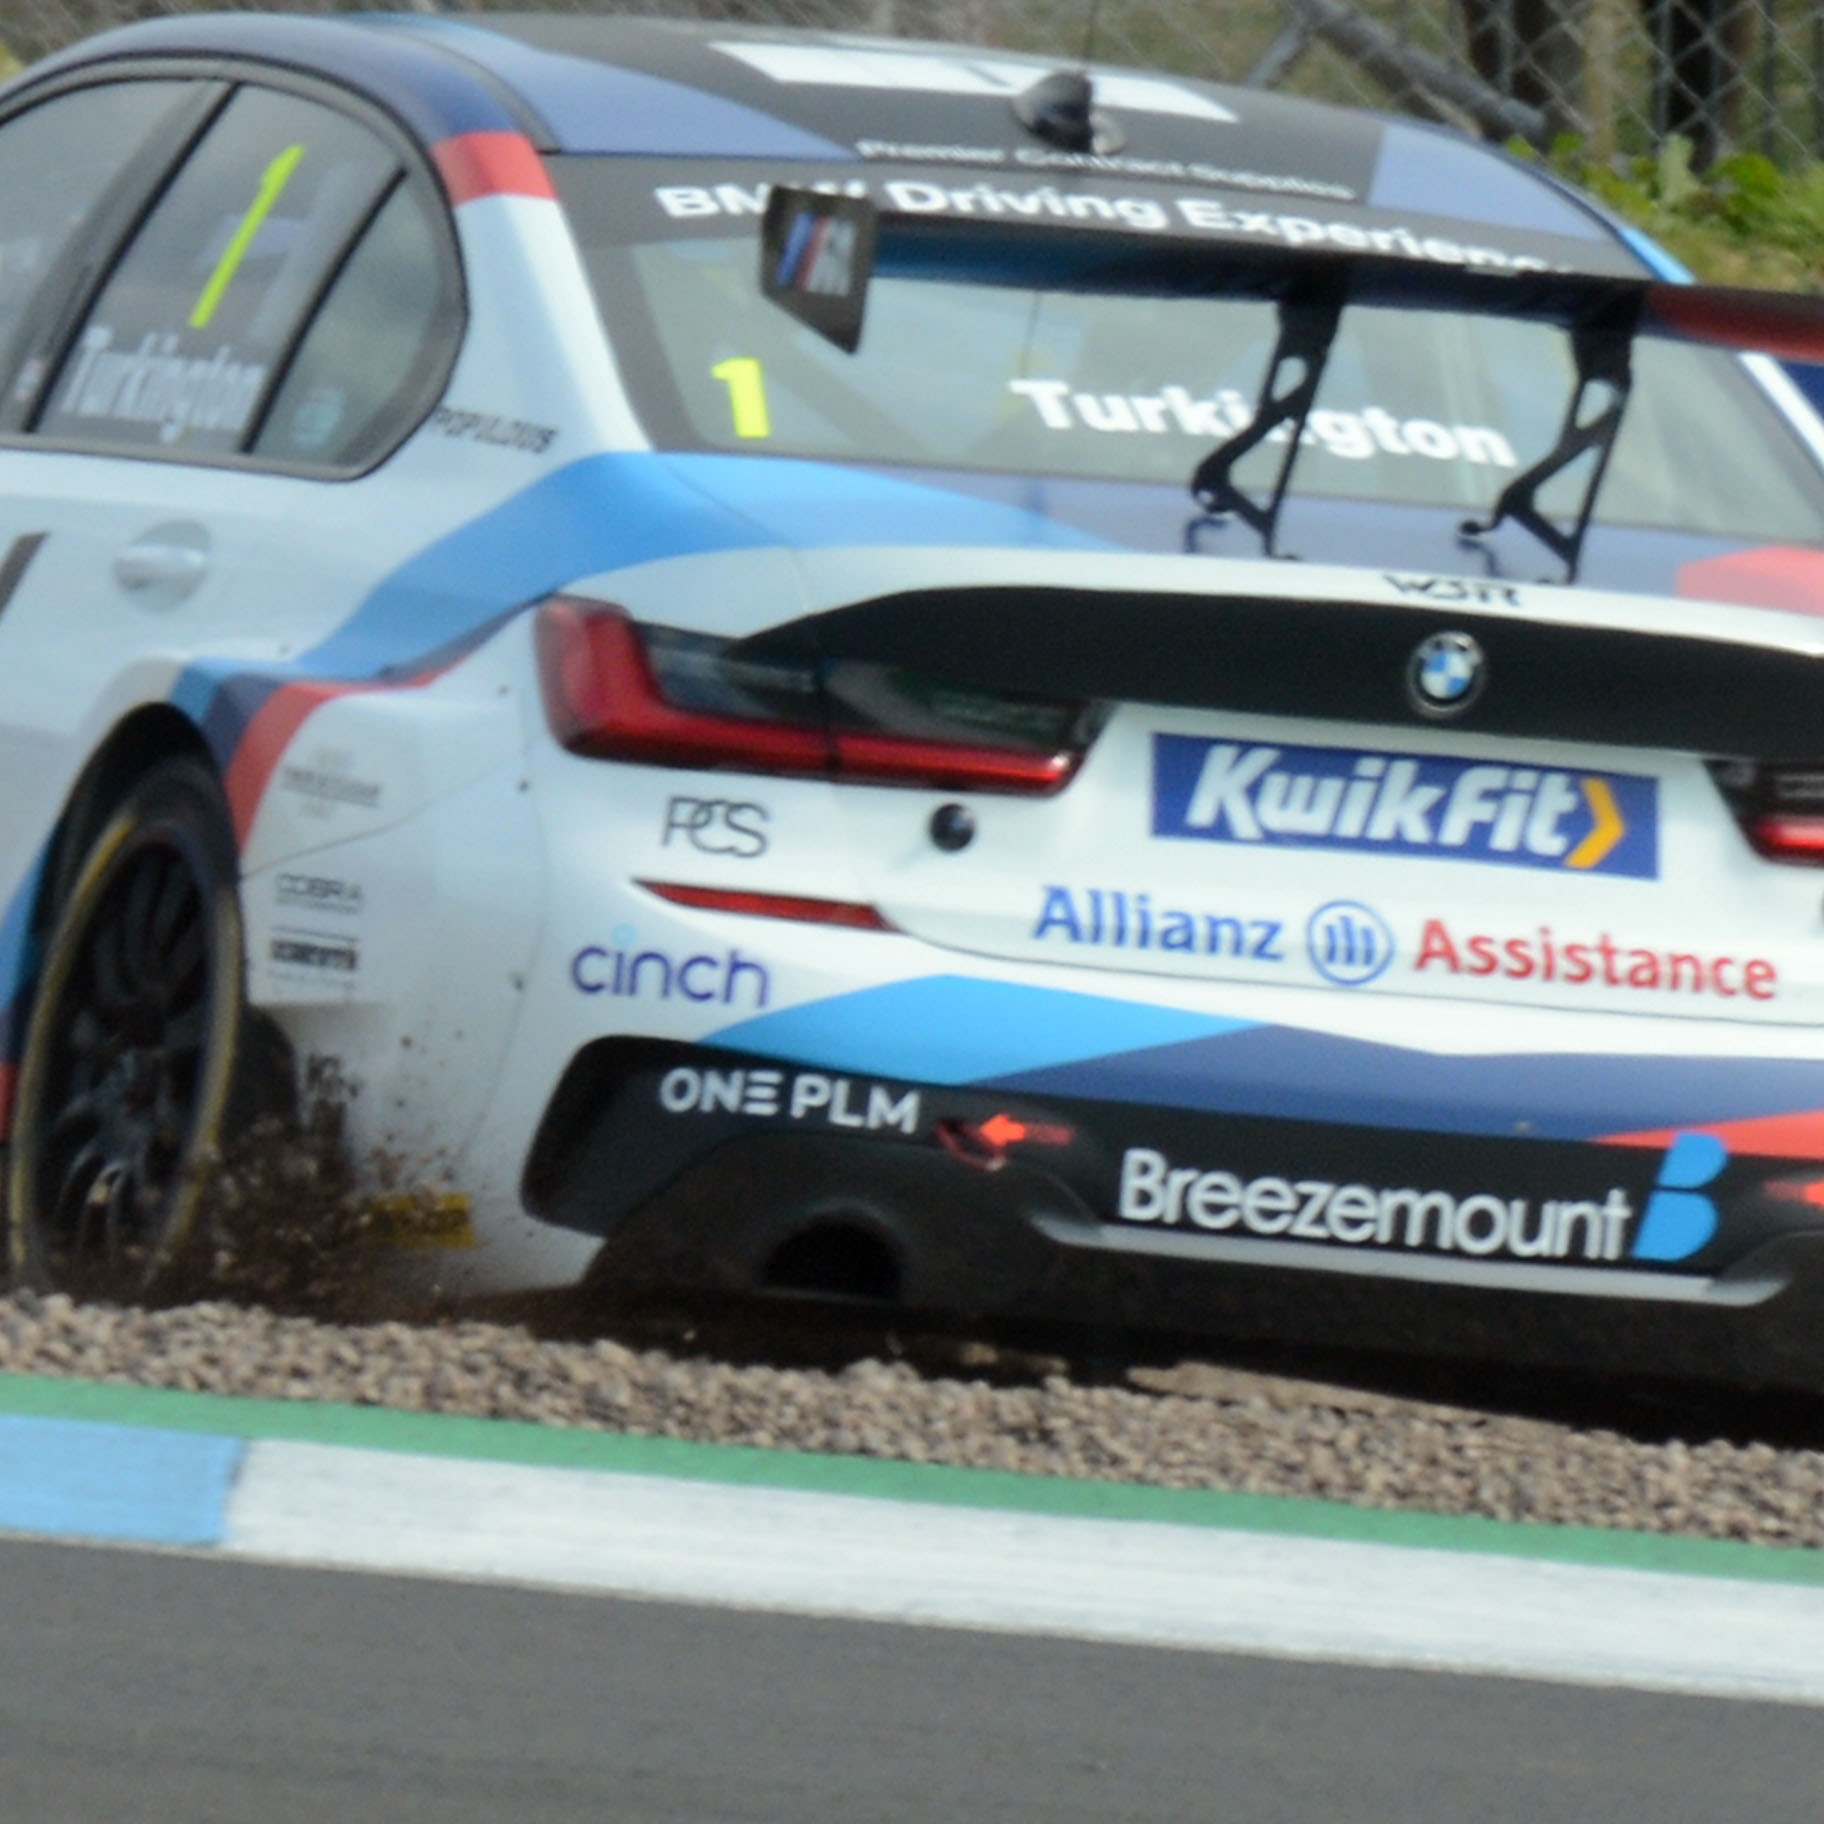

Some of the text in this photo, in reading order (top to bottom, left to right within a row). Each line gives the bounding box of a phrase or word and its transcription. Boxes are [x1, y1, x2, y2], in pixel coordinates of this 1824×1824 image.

[188, 143, 306, 328] 1
[654, 179, 1576, 276] BM Driving Experienc
[711, 357, 771, 439] 1
[661, 795, 770, 859] PCS
[571, 921, 770, 1008] cinch
[1032, 884, 1779, 1001] Allianz Assistance
[658, 1066, 921, 1135] ONE PLM
[1116, 1147, 1632, 1261] Breezemount
